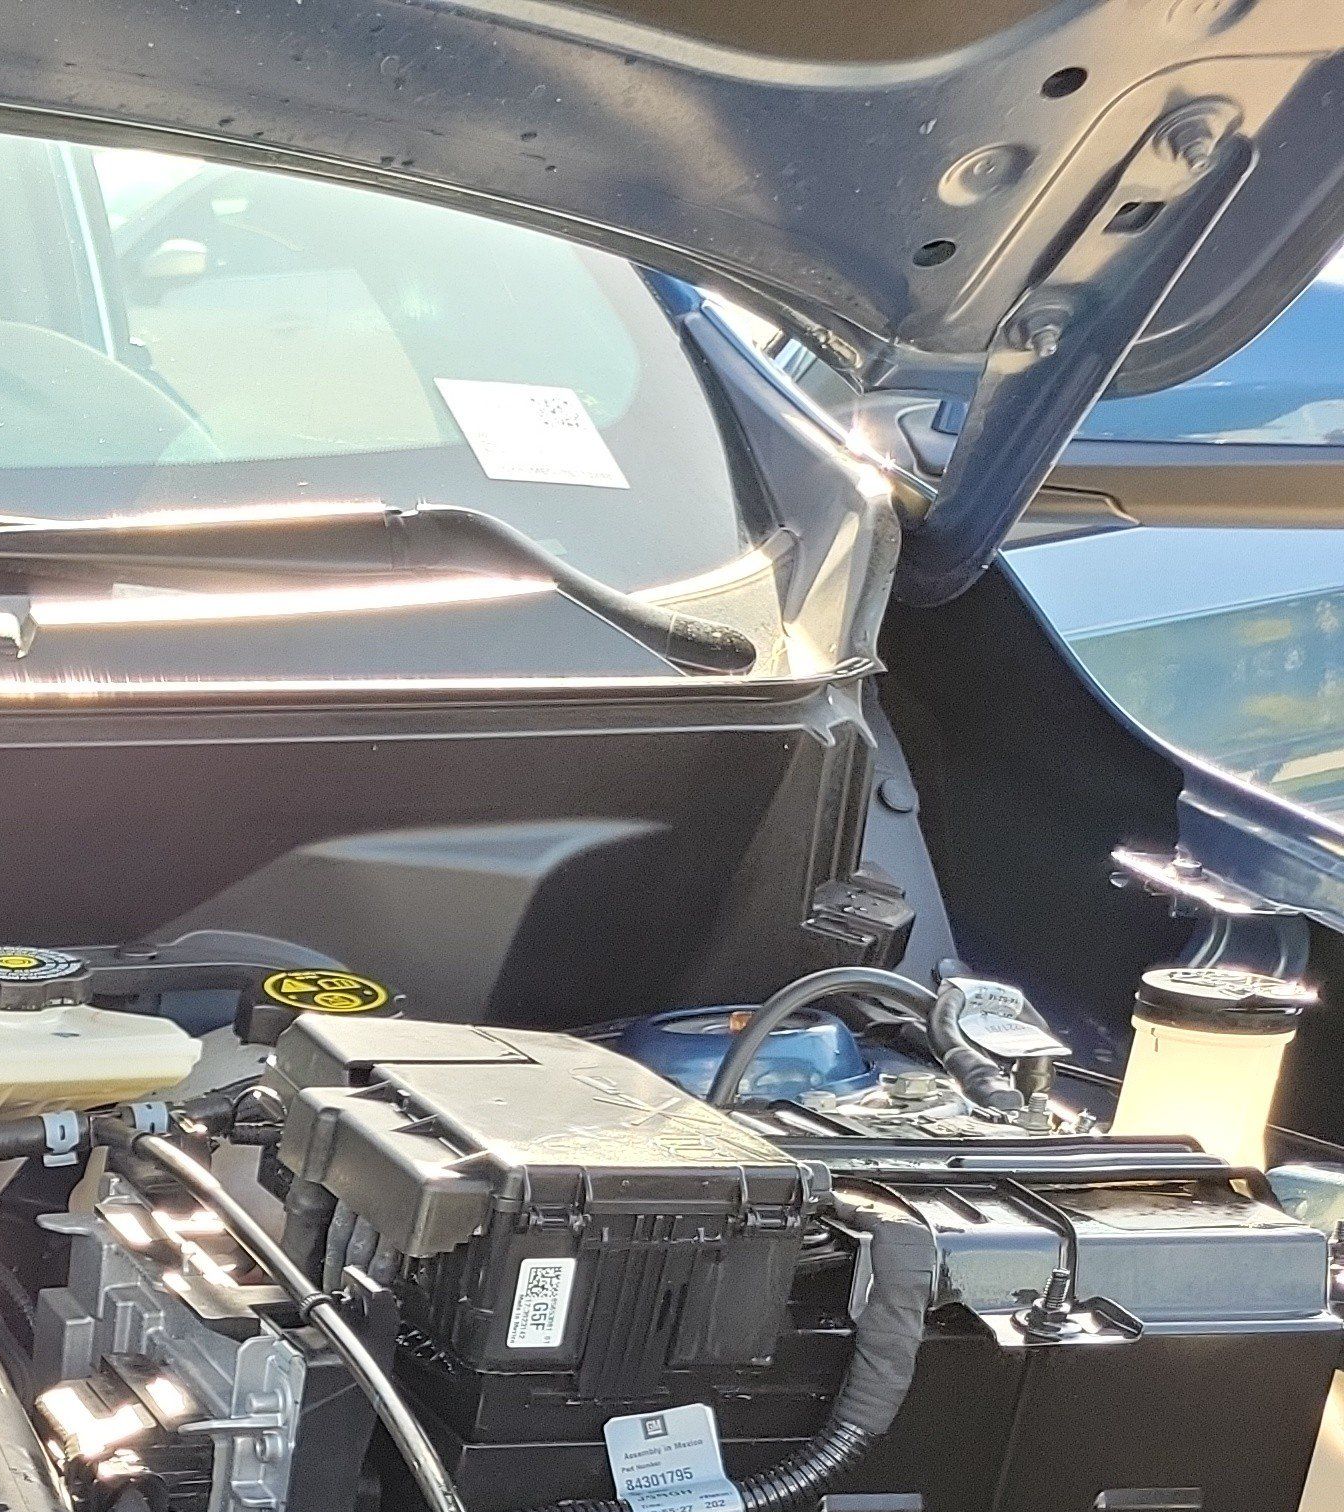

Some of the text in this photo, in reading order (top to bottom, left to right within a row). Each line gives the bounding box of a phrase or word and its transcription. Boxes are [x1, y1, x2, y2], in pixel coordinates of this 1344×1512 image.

[530, 1302, 549, 1331] G5F
[623, 1446, 662, 1461] Assembly
[673, 1438, 704, 1451] Mexico
[625, 1466, 694, 1491] 84301795
[704, 1499, 726, 1509] 202
